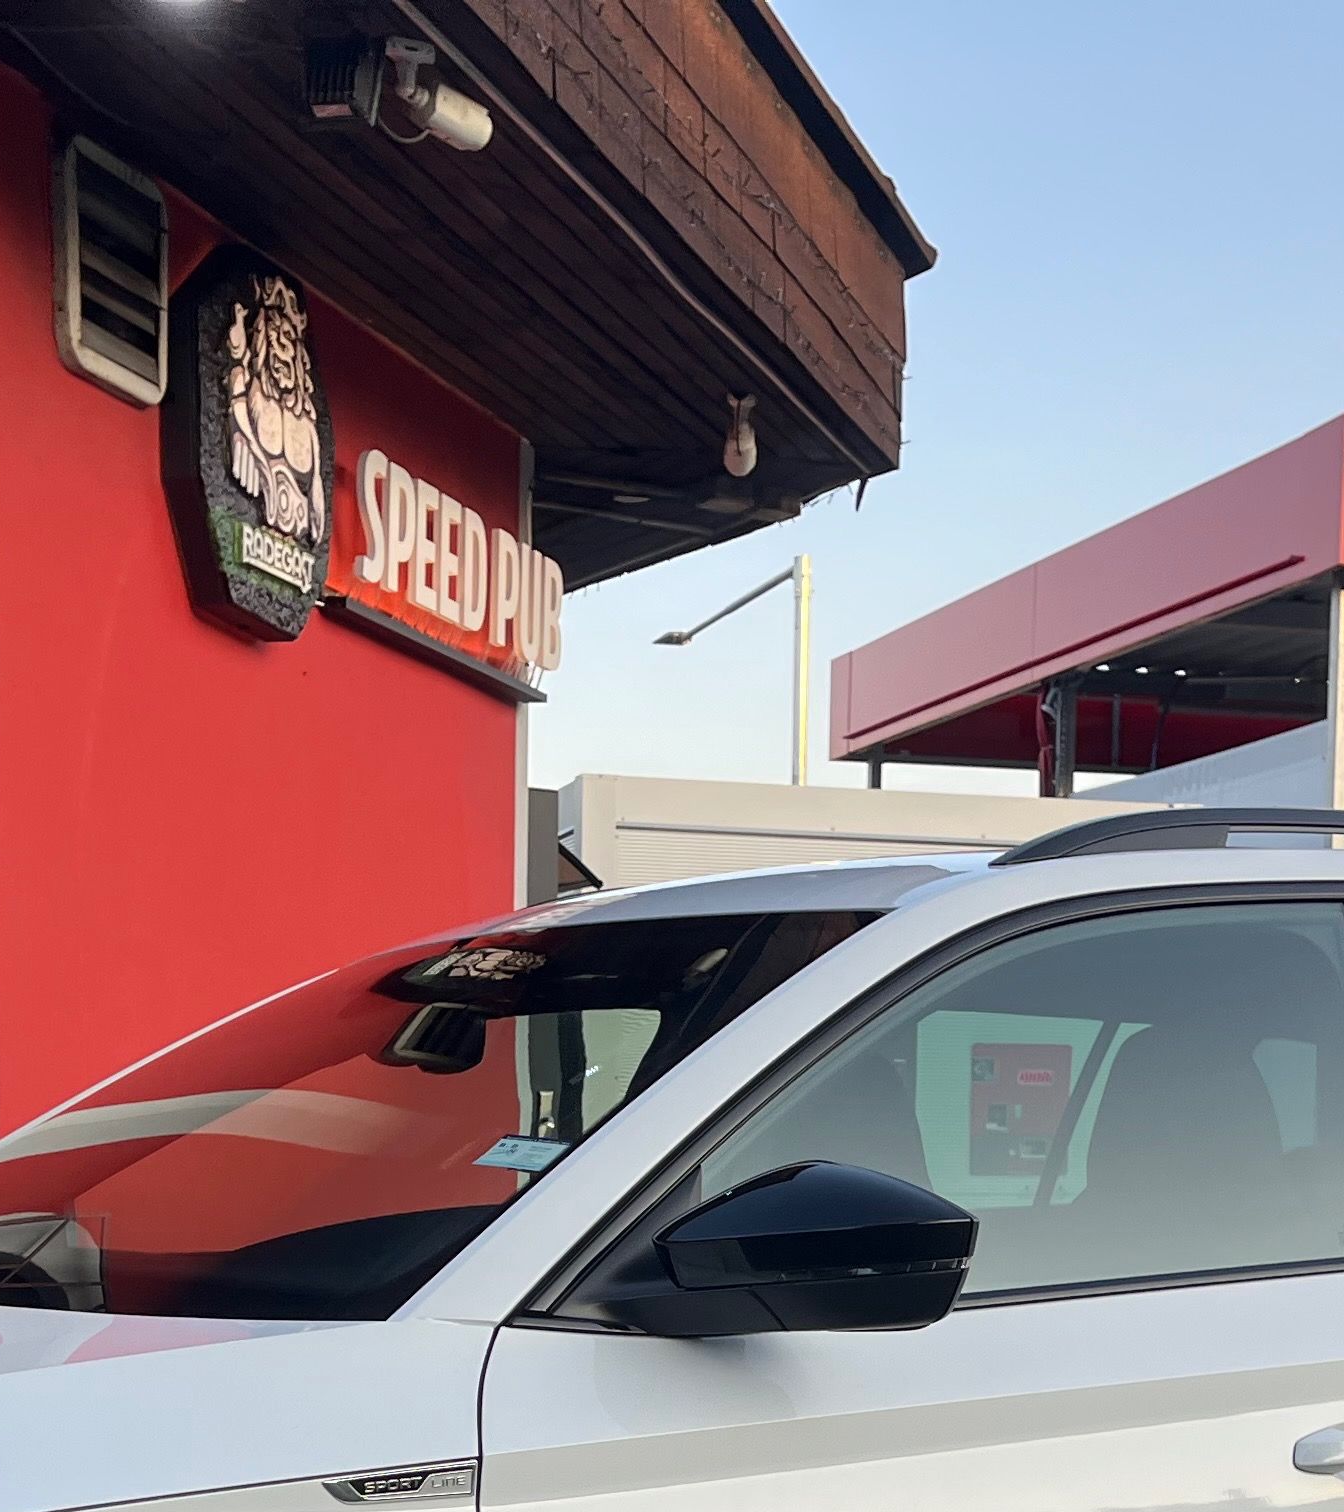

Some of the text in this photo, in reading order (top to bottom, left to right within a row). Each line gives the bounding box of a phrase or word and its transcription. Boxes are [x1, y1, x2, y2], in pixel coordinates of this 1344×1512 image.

[355, 449, 565, 671] SPEED PUB
[364, 1476, 423, 1493] SPORT
